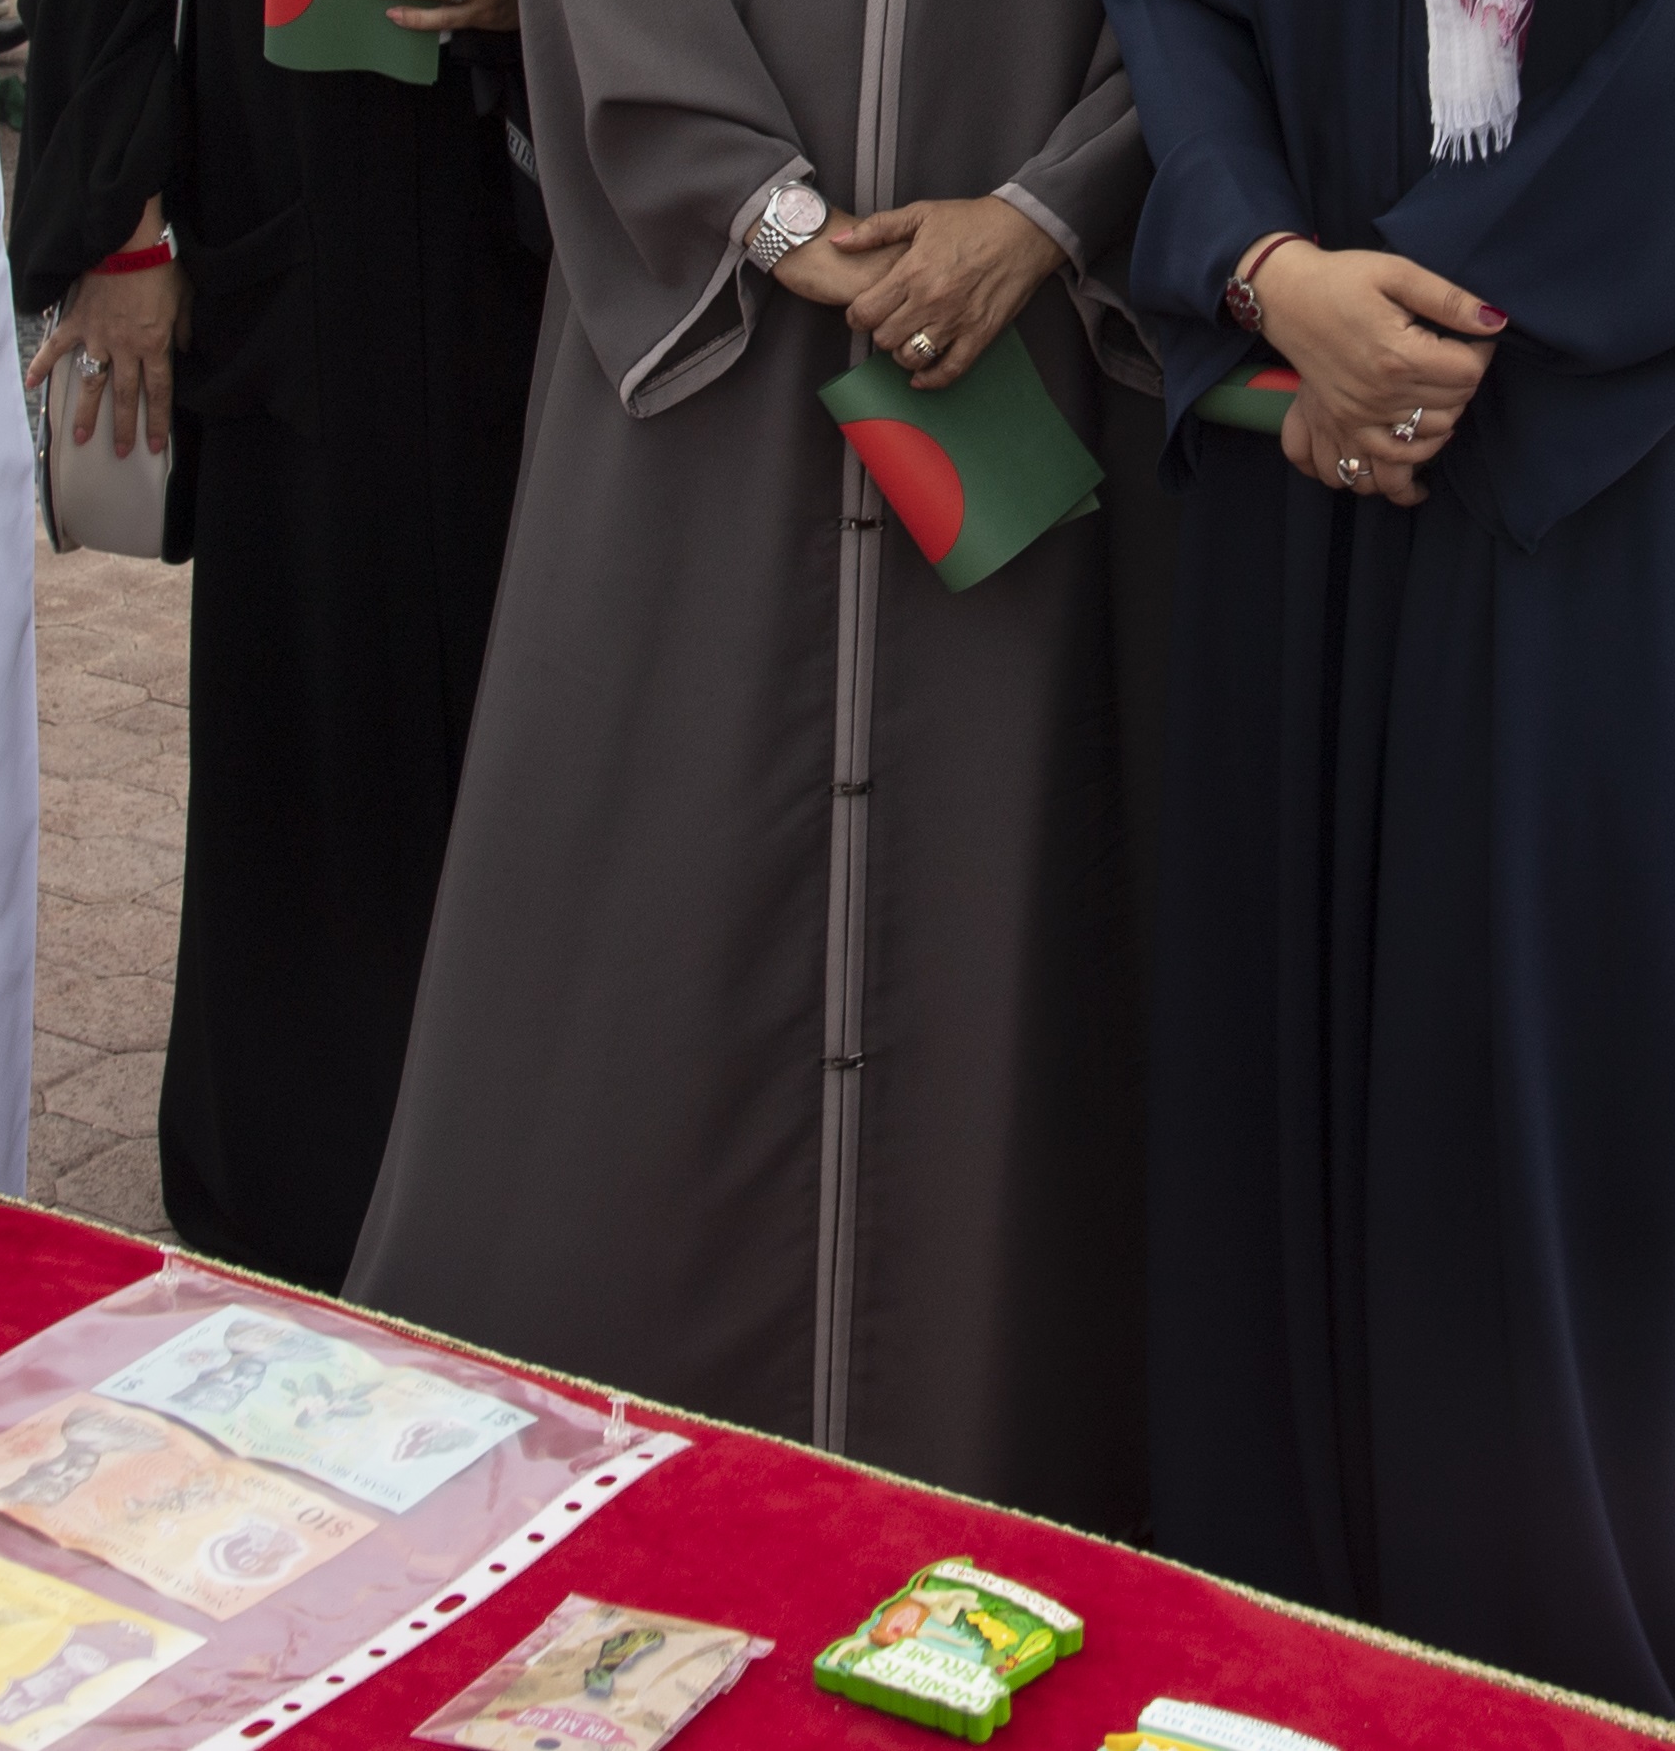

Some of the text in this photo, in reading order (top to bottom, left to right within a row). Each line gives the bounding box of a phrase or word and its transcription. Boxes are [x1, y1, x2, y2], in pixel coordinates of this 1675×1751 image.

[294, 1502, 356, 1540] $10
[863, 1654, 987, 1712] WONDERS
[882, 1644, 981, 1685] BRUNEI
